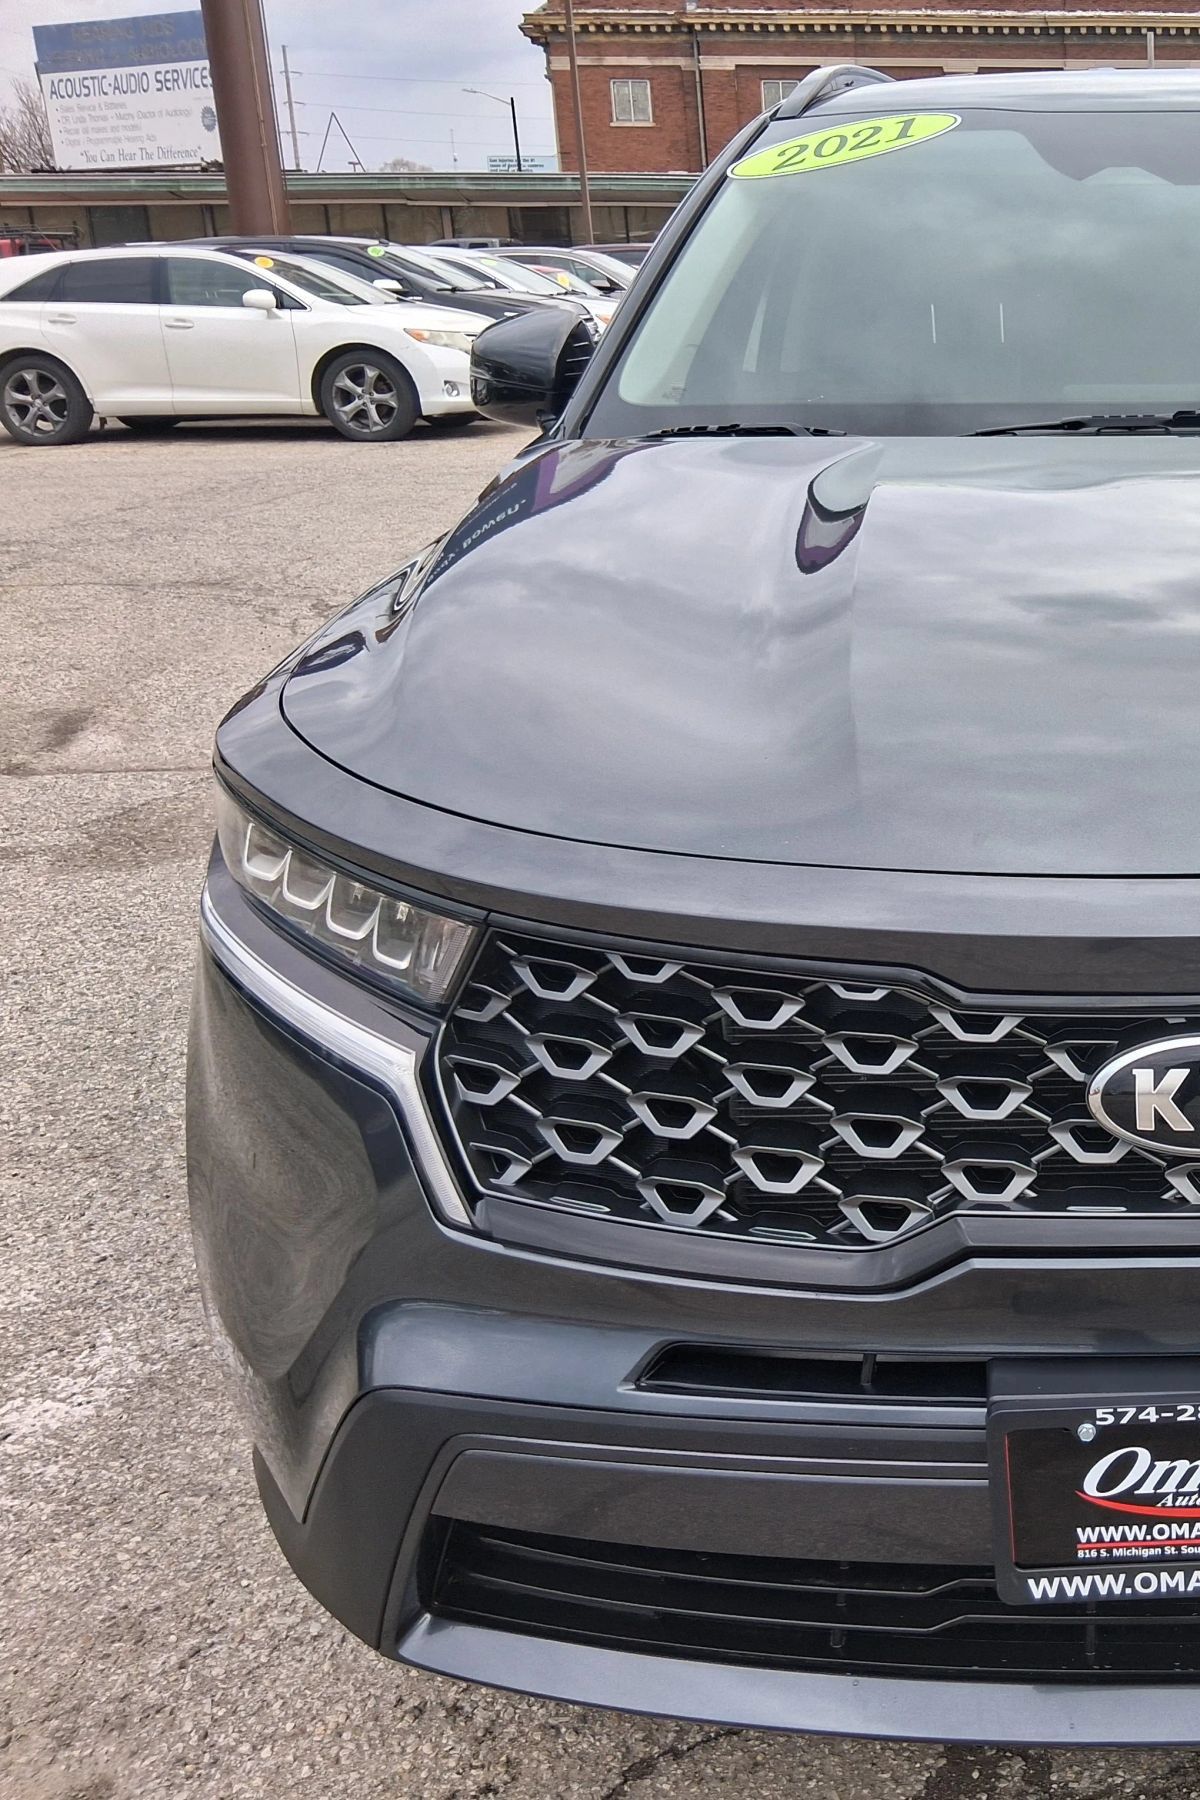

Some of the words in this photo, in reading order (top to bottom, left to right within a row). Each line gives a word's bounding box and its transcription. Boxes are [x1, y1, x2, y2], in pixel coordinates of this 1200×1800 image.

[772, 117, 917, 171] 2021
[100, 149, 115, 162] Can
[118, 148, 136, 161] Hear
[138, 147, 154, 160] The
[1077, 1549, 1098, 1559] 816
[1100, 1548, 1110, 1558] S.
[1112, 1546, 1162, 1558] Michigan
[1164, 1545, 1178, 1555] St.
